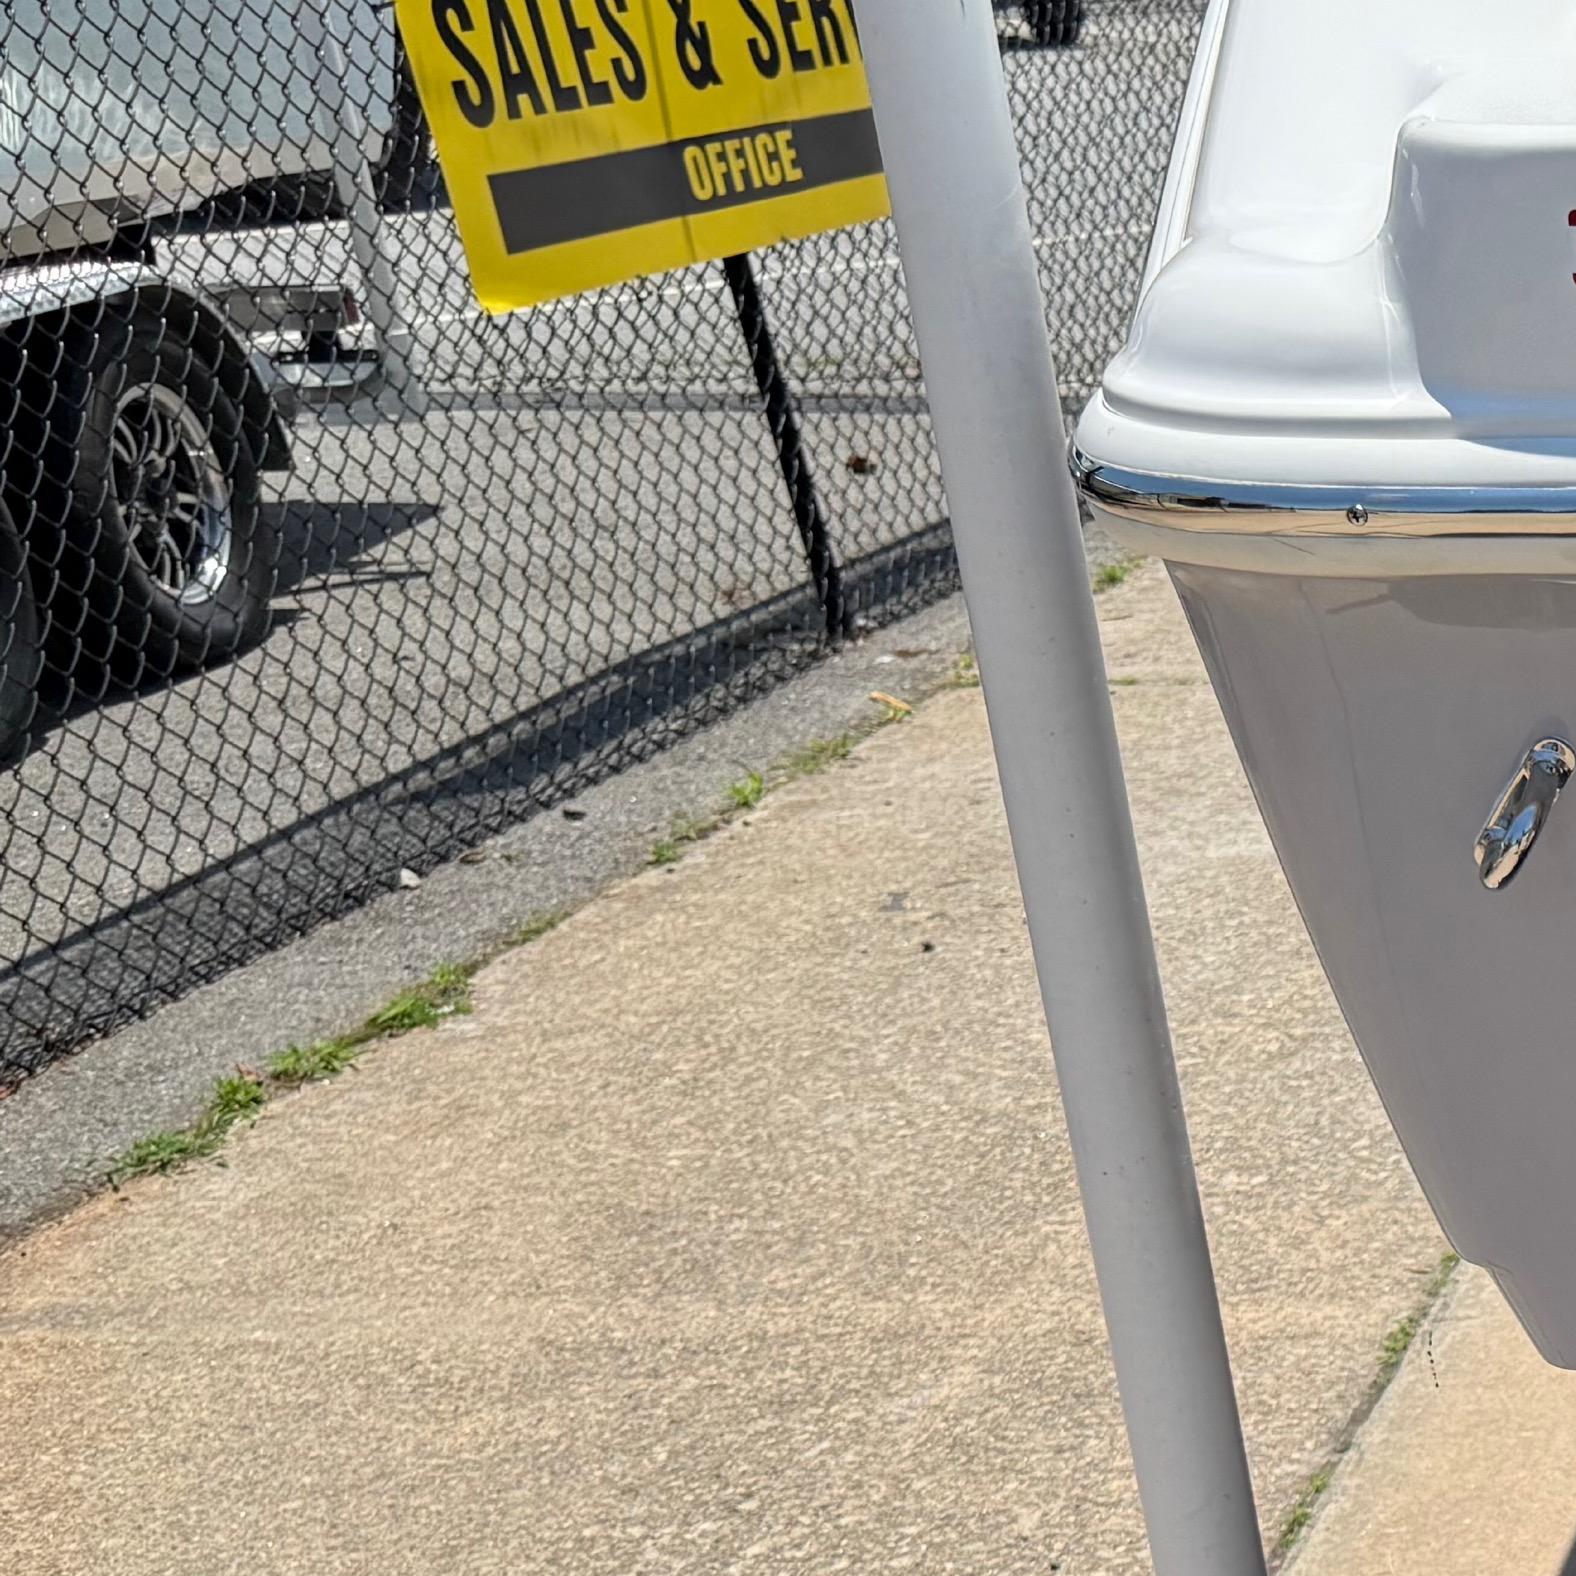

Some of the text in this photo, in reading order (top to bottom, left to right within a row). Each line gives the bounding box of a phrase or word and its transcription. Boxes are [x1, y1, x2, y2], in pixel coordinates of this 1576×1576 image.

[431, 0, 648, 128] SALES
[669, 0, 723, 90] &
[682, 130, 803, 201] OFFICE
